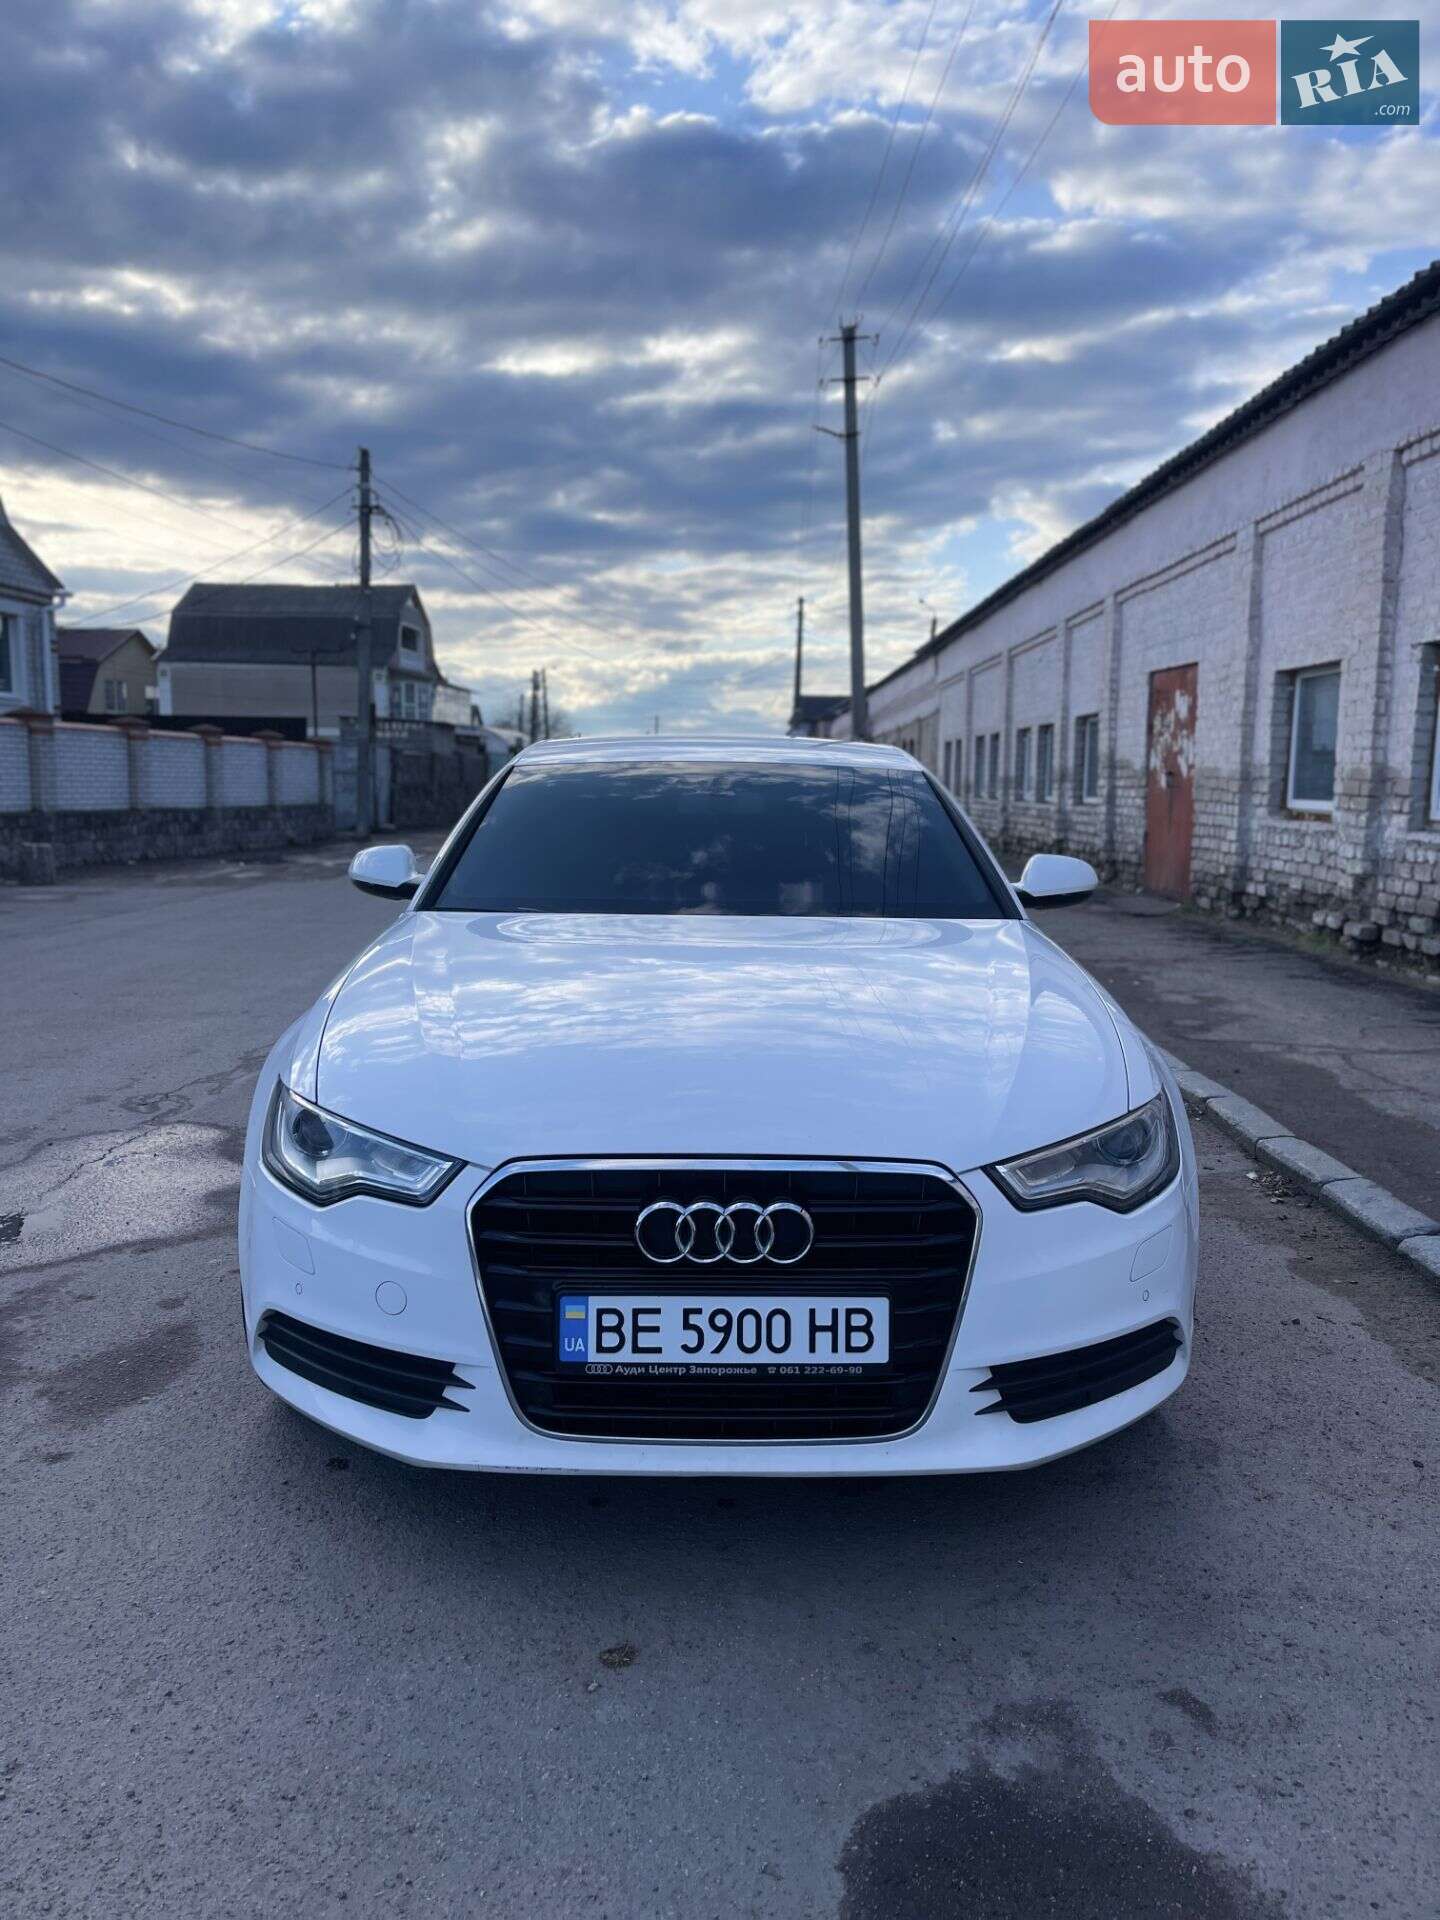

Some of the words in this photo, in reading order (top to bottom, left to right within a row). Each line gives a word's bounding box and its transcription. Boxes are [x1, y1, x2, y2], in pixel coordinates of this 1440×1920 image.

[595, 1307, 663, 1354] BE
[680, 1307, 792, 1354] 5900
[808, 1307, 875, 1354] HB
[564, 1338, 586, 1352] UA
[615, 1365, 645, 1376] Ауди
[648, 1365, 687, 1376] Центр
[689, 1365, 757, 1376] Запорожье
[779, 1366, 800, 1375] 061
